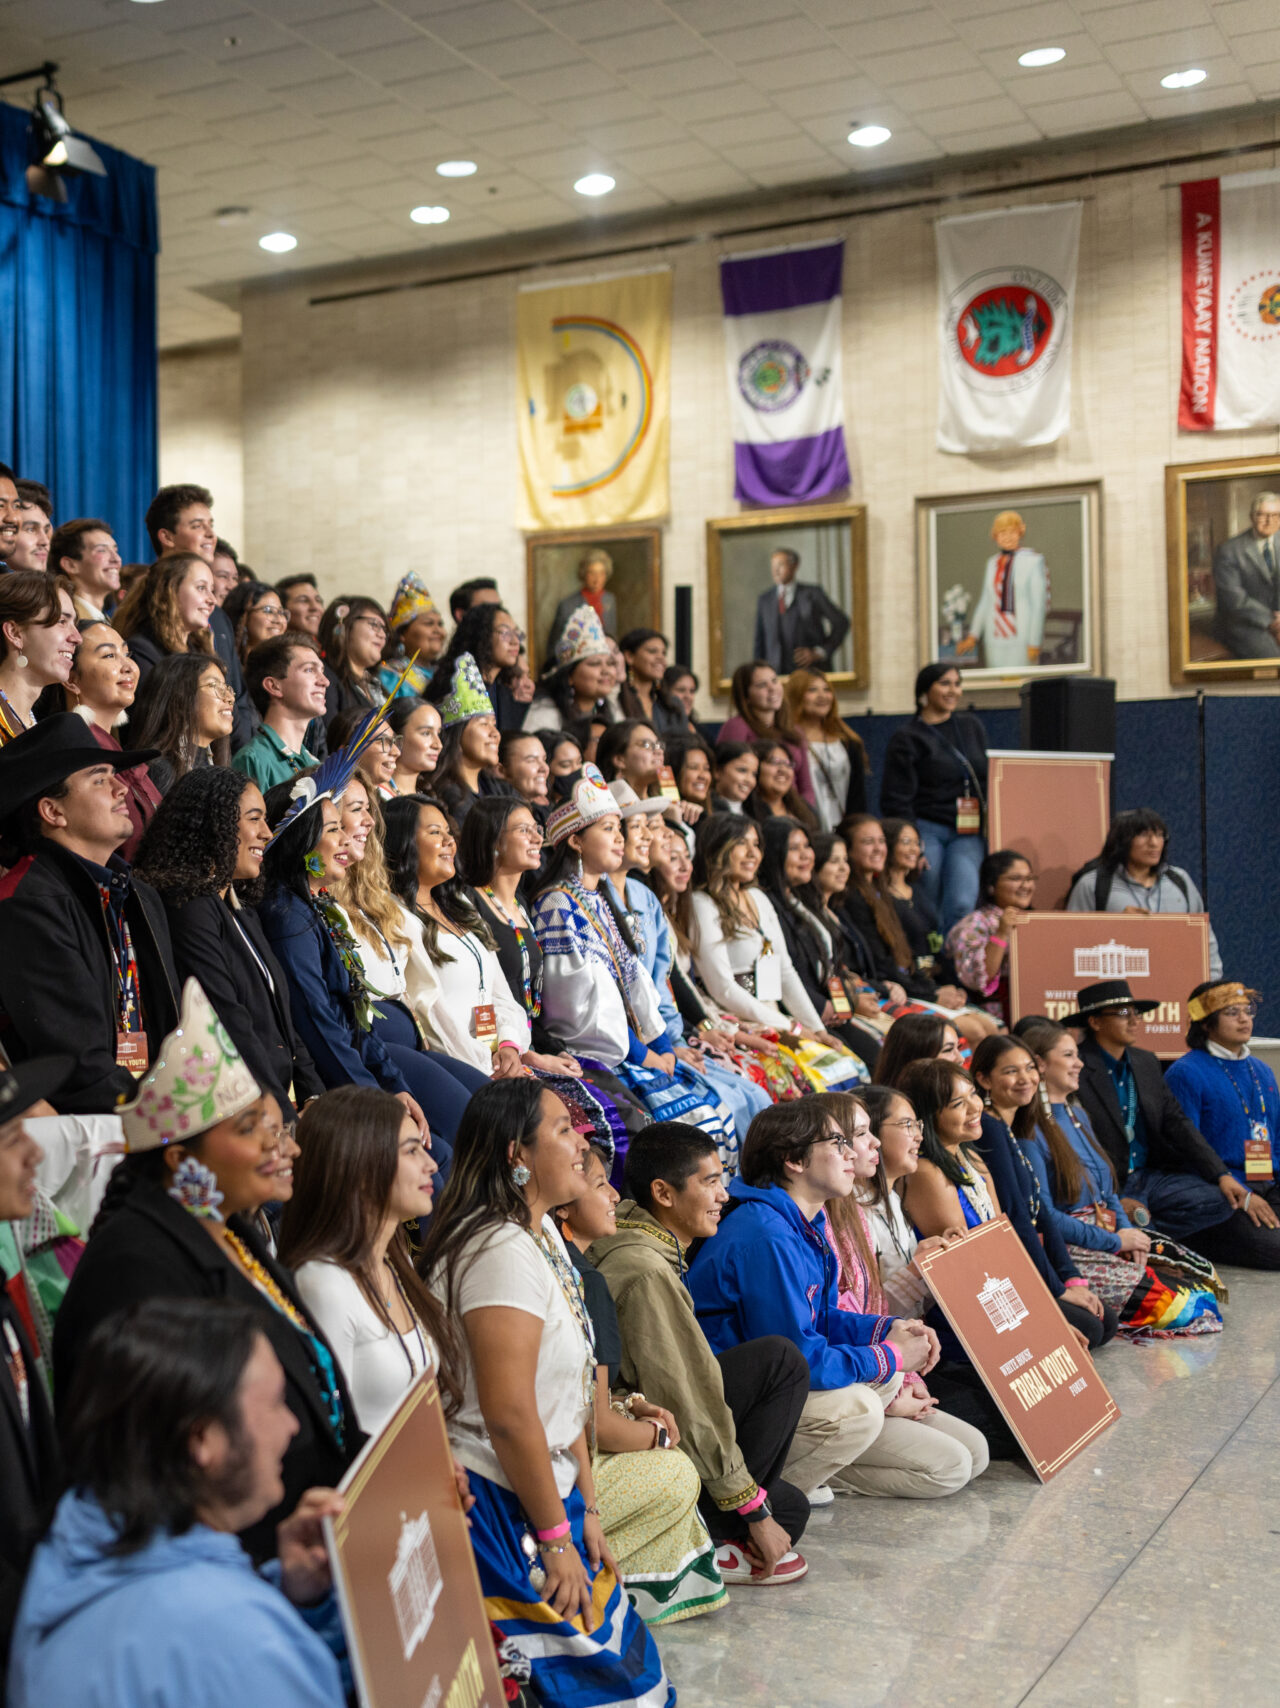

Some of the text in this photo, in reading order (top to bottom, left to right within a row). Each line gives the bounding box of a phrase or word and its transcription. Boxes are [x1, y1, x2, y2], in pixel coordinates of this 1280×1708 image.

[1192, 212, 1214, 414] A KUMEYAAY NATION
[1144, 1024, 1181, 1034] FORUM
[1009, 1344, 1079, 1411] TRIBAL YOUTH
